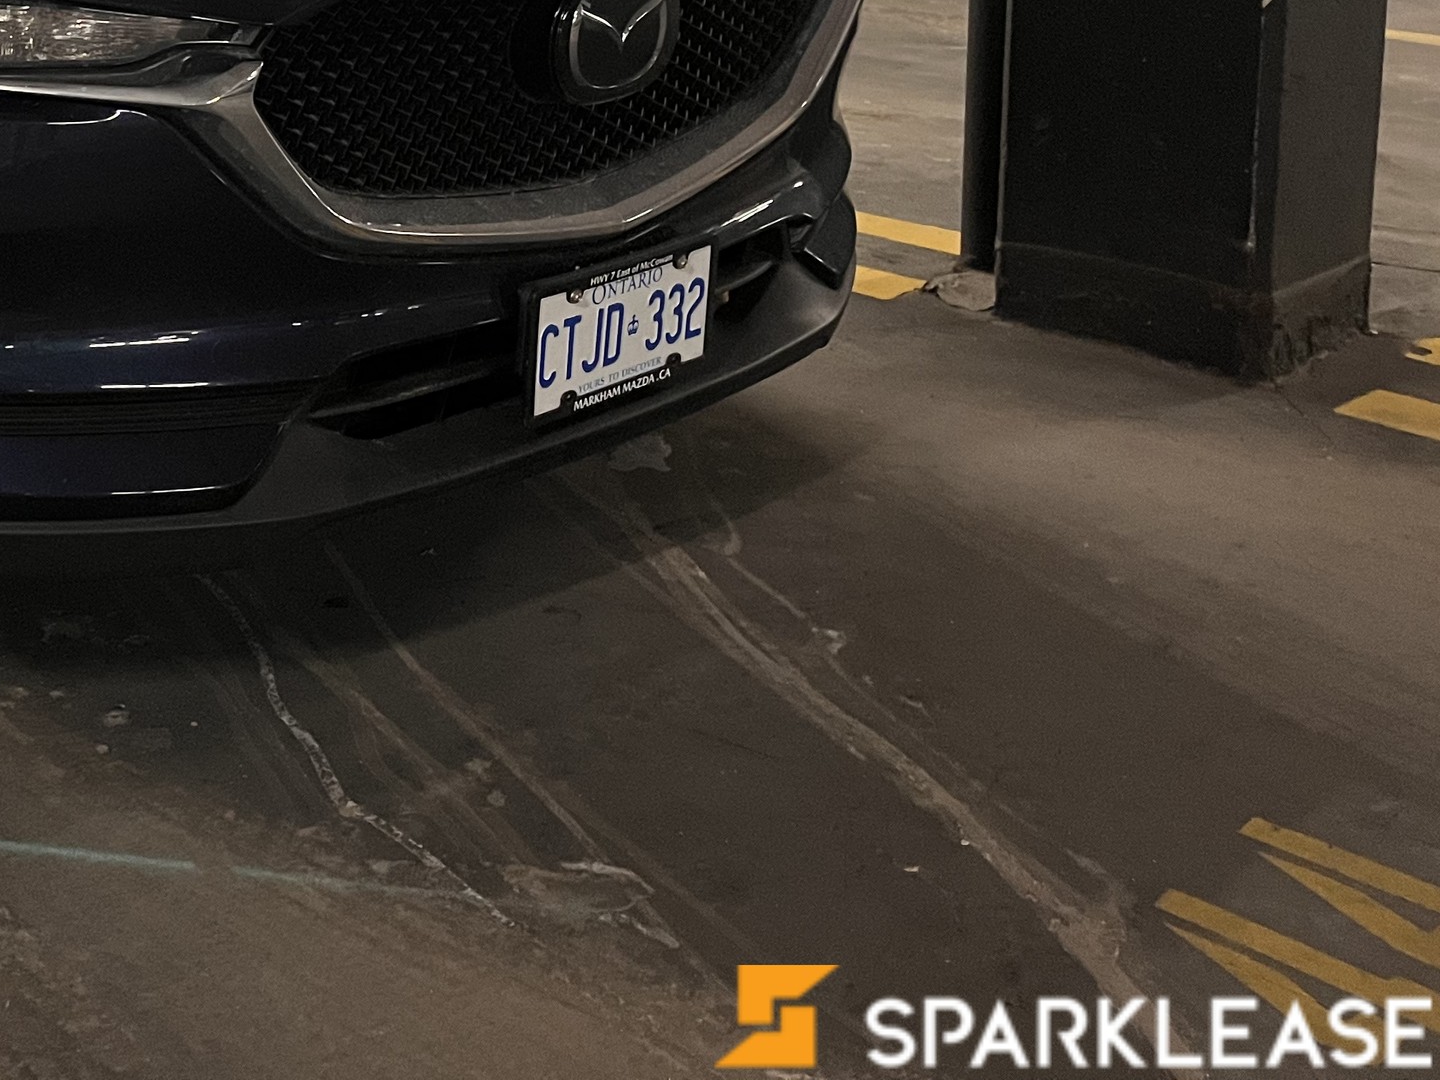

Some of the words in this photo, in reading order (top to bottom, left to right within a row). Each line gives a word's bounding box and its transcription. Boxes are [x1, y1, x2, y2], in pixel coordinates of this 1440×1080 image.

[592, 266, 663, 305] ONTARIO
[538, 301, 625, 389] CTJD
[645, 276, 705, 351] 332
[578, 376, 605, 394] YOURS
[608, 371, 620, 383] TO
[621, 356, 662, 378] DISCOVER
[573, 385, 621, 411] MARKHAM
